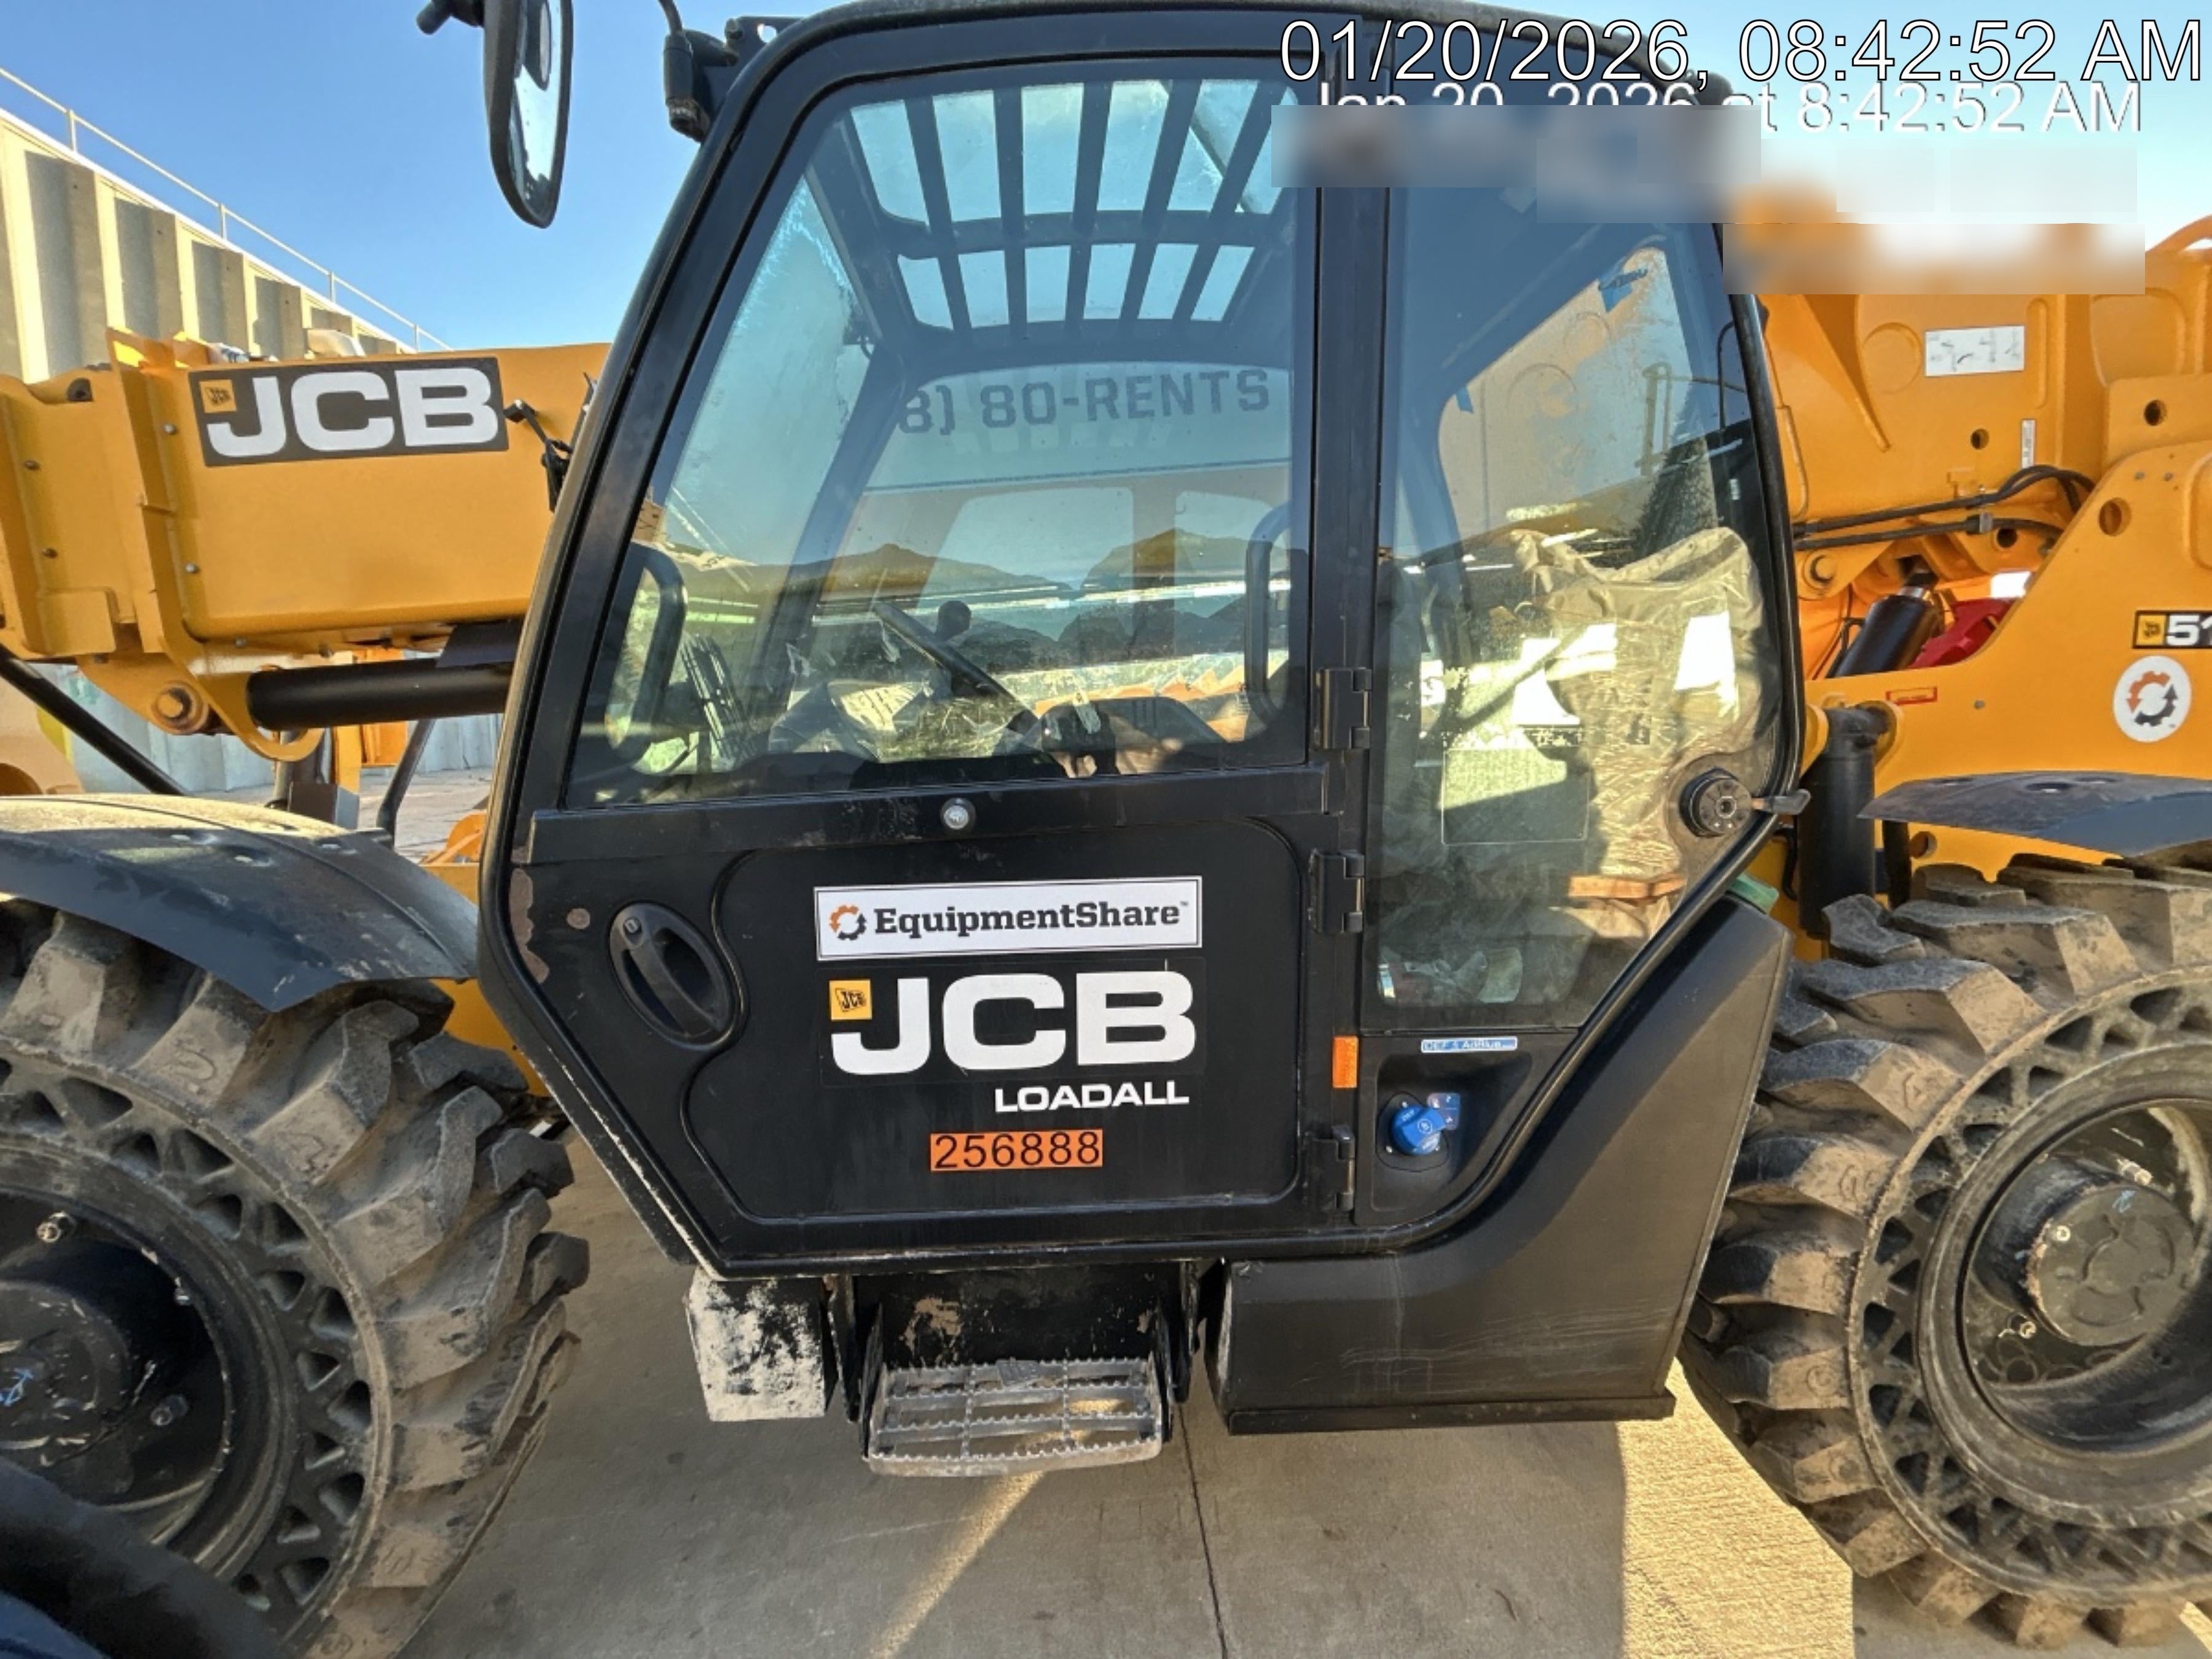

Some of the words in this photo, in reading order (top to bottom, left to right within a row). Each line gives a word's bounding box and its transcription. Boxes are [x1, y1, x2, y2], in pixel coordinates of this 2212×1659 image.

[206, 368, 499, 458] JCB
[980, 369, 1269, 428] 80-RENTS
[831, 970, 1196, 1075] JCB
[995, 1081, 1190, 1113] LOADALL
[935, 1132, 1100, 1169] 256888
